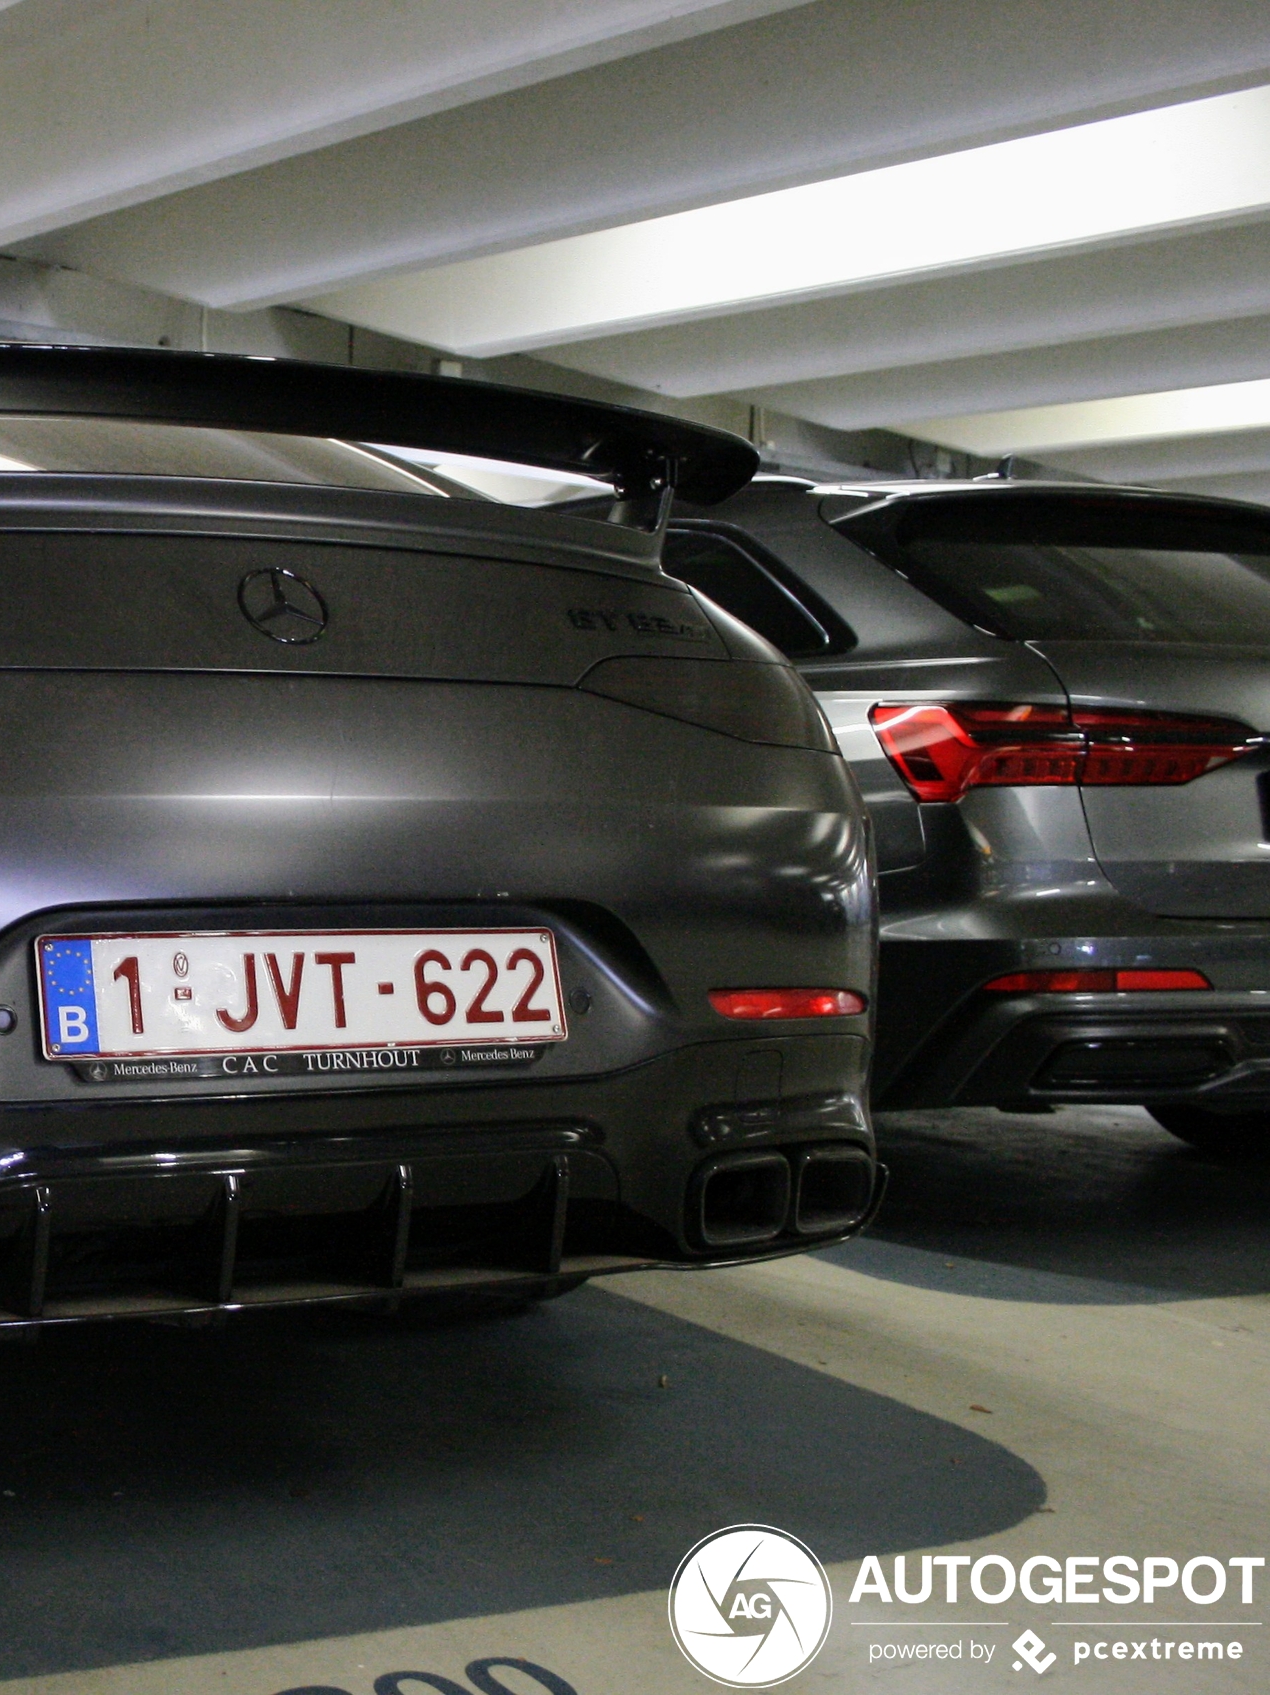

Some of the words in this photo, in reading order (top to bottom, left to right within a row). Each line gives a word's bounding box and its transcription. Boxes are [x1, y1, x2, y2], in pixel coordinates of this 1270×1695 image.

[58, 1005, 90, 1043] B
[114, 1062, 198, 1076] Mercedes-Benz
[303, 1050, 421, 1071] TURNHOUT
